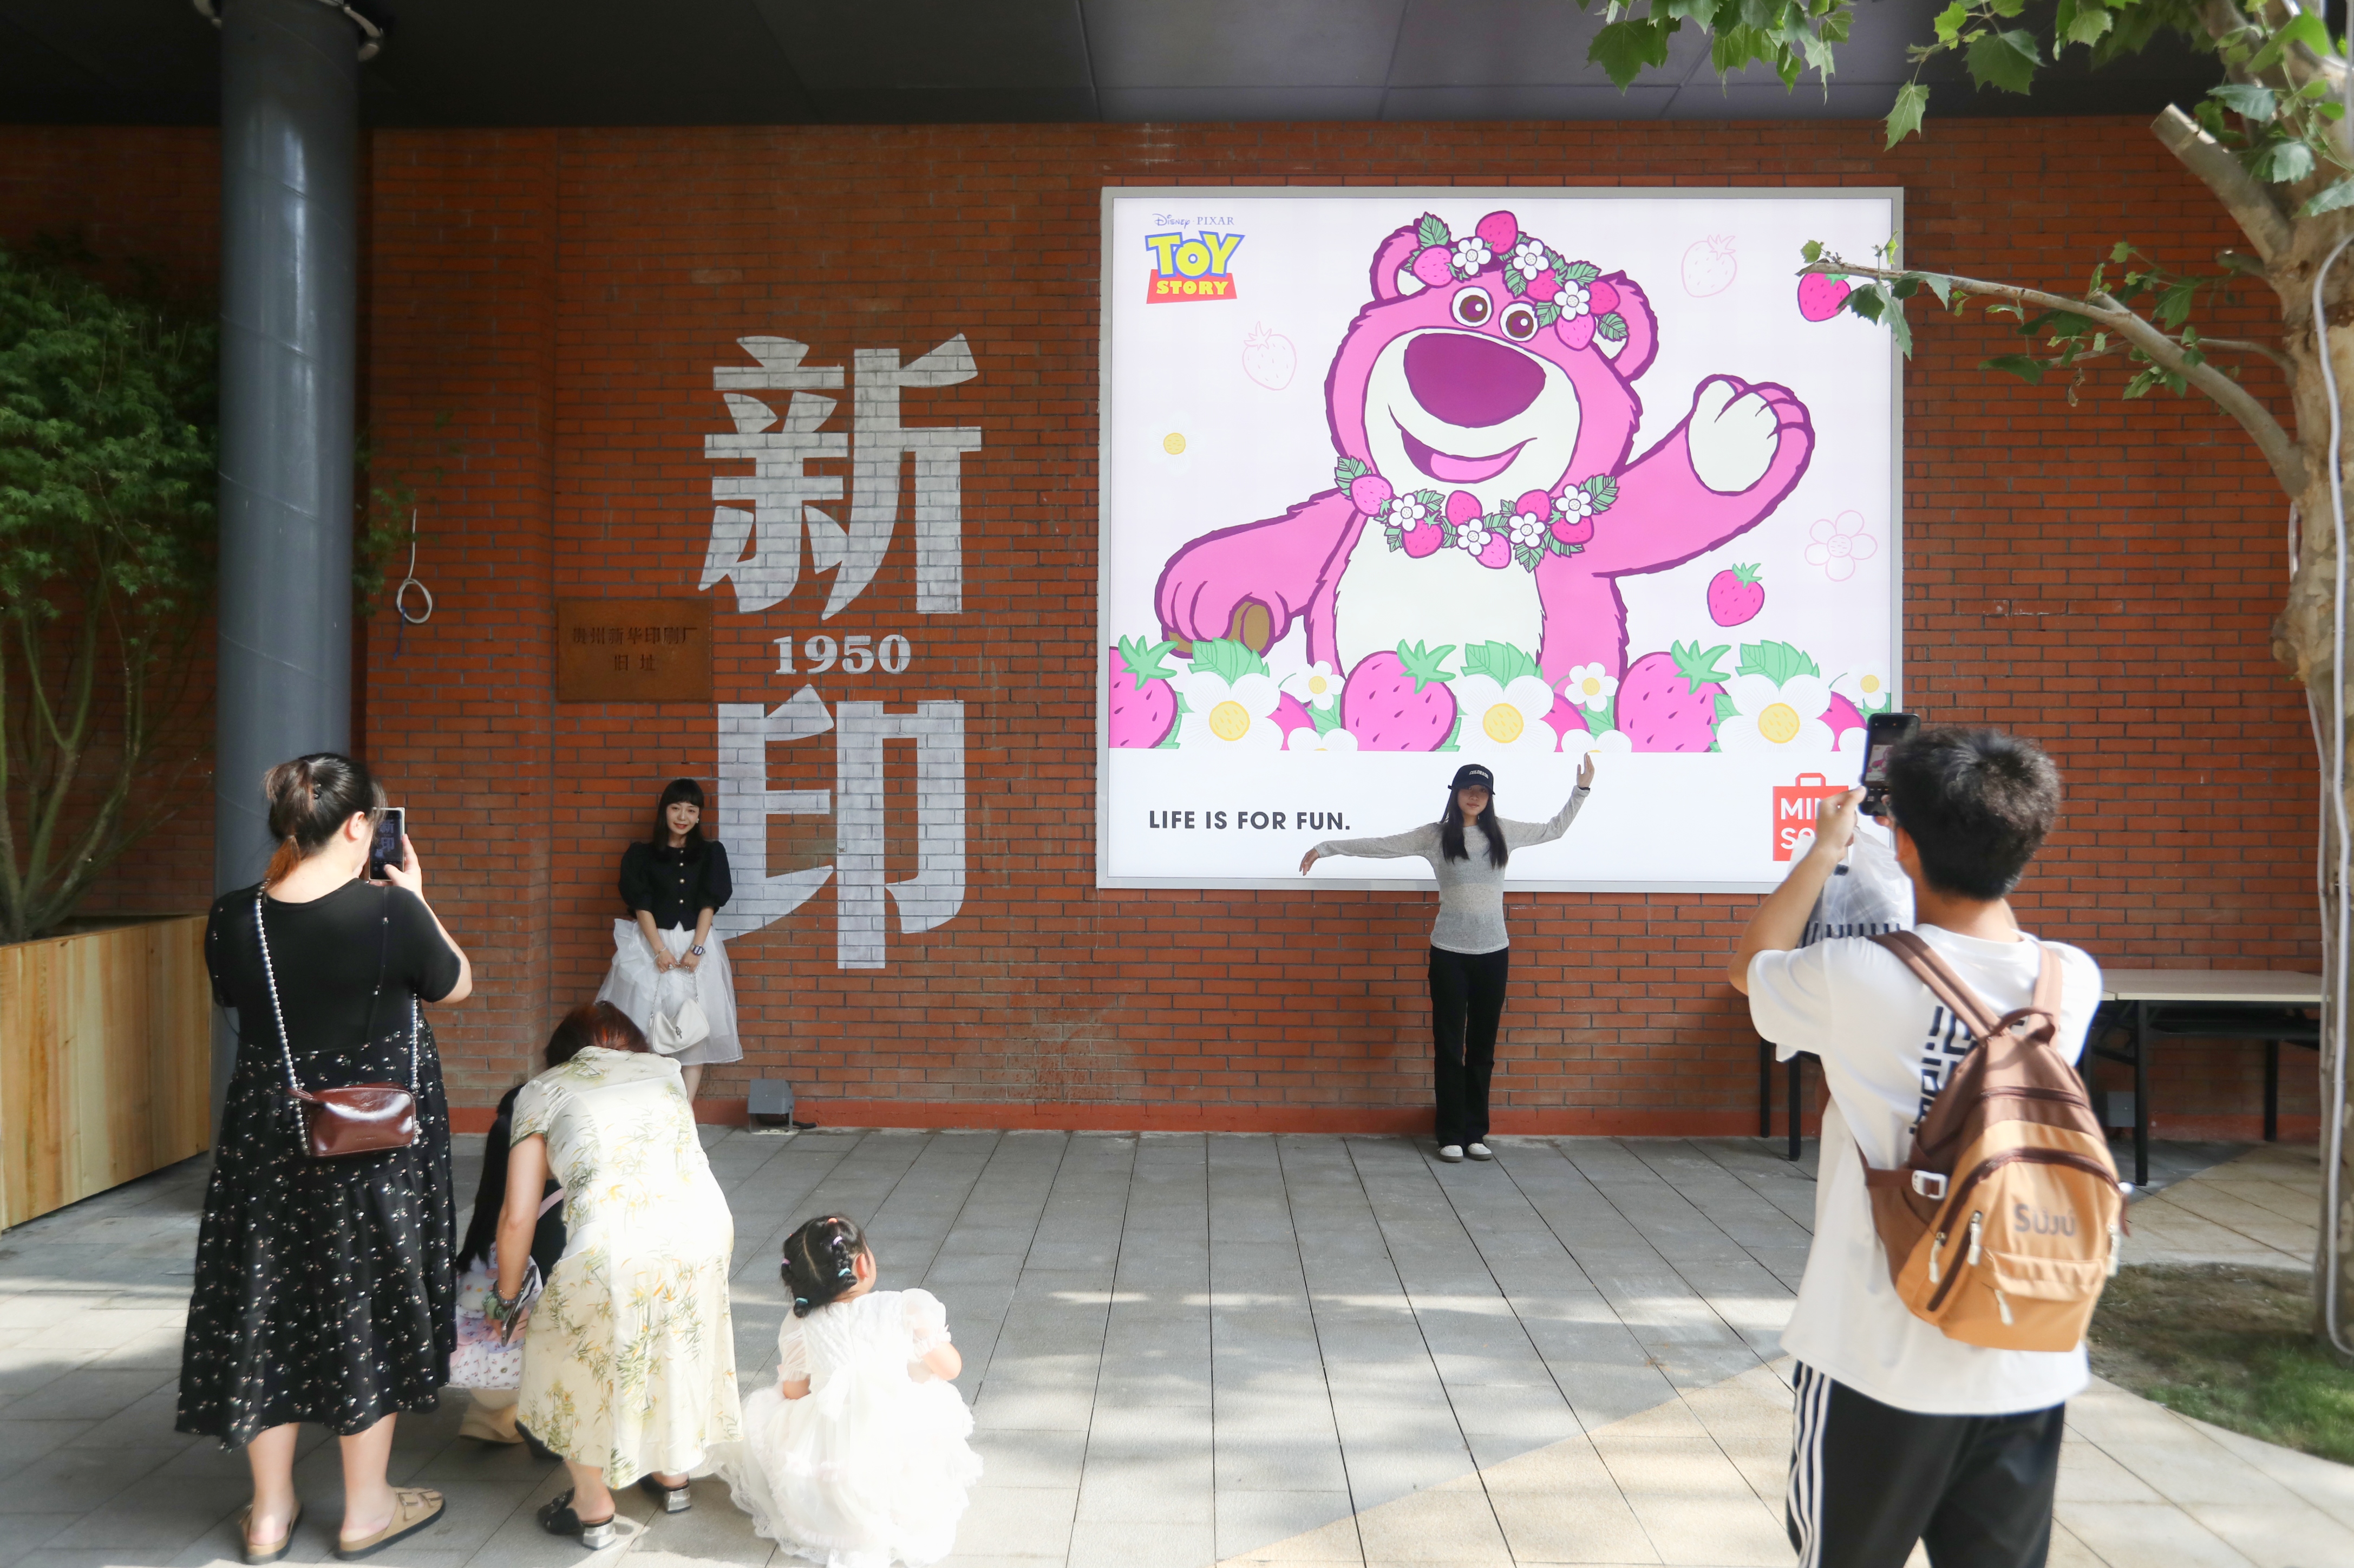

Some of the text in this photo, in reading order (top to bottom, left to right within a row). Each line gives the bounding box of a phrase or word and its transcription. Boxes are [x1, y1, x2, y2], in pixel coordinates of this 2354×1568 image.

[1196, 217, 1234, 225] PIXAR
[1145, 231, 1245, 279] TOY
[1156, 280, 1228, 295] STORY
[698, 333, 982, 620] 新
[573, 627, 697, 644] 贵州新华印刷厂
[773, 634, 911, 675] 1950
[1149, 810, 1350, 830] LIFE IS FOR FUN.
[1781, 798, 1822, 820] MI
[714, 683, 966, 969] 印
